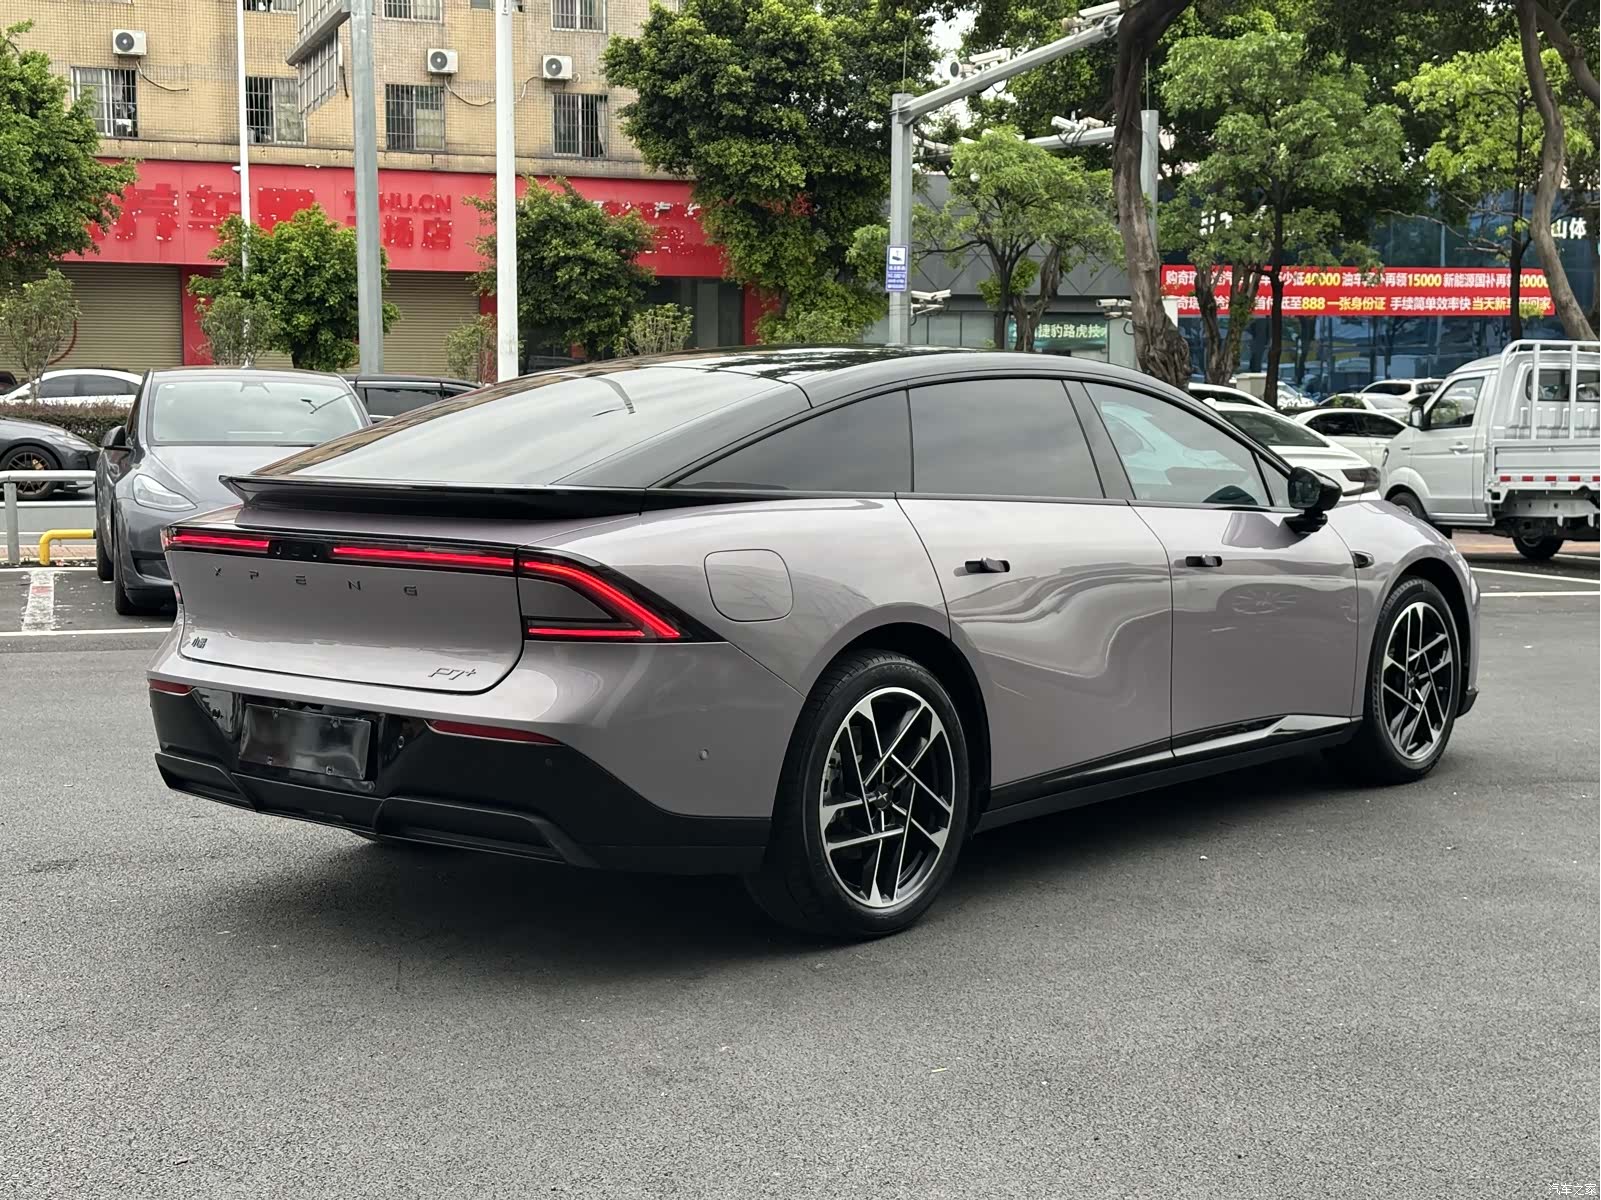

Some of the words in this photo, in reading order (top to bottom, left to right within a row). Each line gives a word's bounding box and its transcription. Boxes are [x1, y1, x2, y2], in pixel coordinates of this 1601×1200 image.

[344, 190, 452, 214] THU.CN
[1034, 323, 1107, 338] 捷豹路虎技
[214, 566, 419, 597] XPENG
[427, 667, 477, 681] P7+
